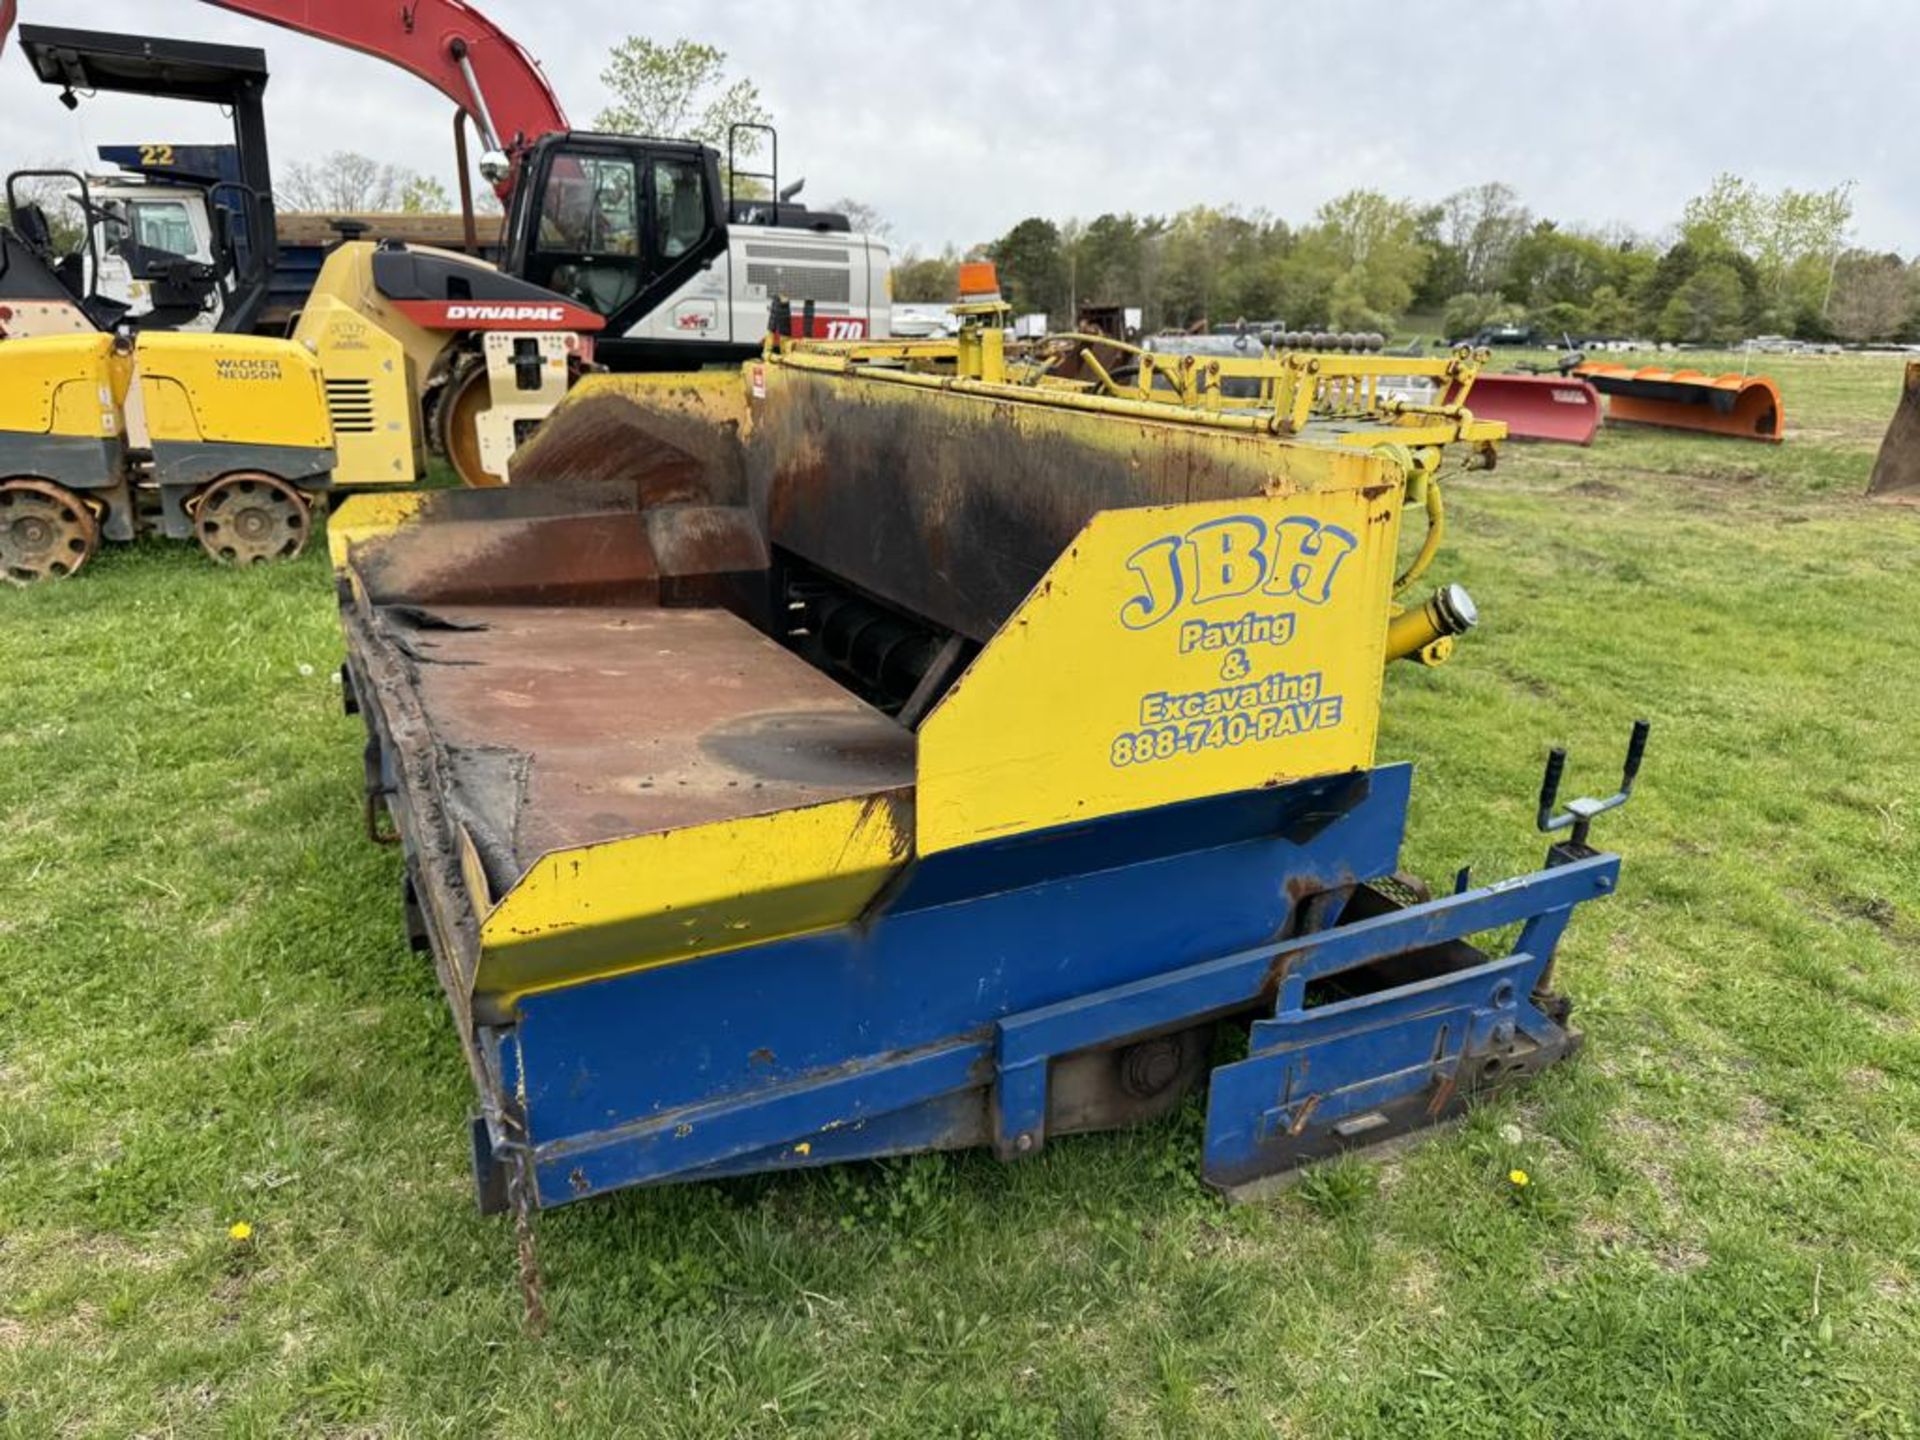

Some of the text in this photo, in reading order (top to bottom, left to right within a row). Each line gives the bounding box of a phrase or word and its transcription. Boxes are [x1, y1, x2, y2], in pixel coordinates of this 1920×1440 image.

[140, 145, 175, 166] 22
[446, 306, 564, 320] DYNAPAC
[826, 321, 863, 340] 170
[215, 359, 279, 369] WACKER
[217, 369, 282, 380] NEUSON
[1121, 515, 1357, 630] JBH
[1180, 612, 1295, 653] Paving
[1220, 648, 1251, 681] &
[1140, 672, 1322, 726] Excavating
[1110, 696, 1343, 767] 888-740-PAVE
